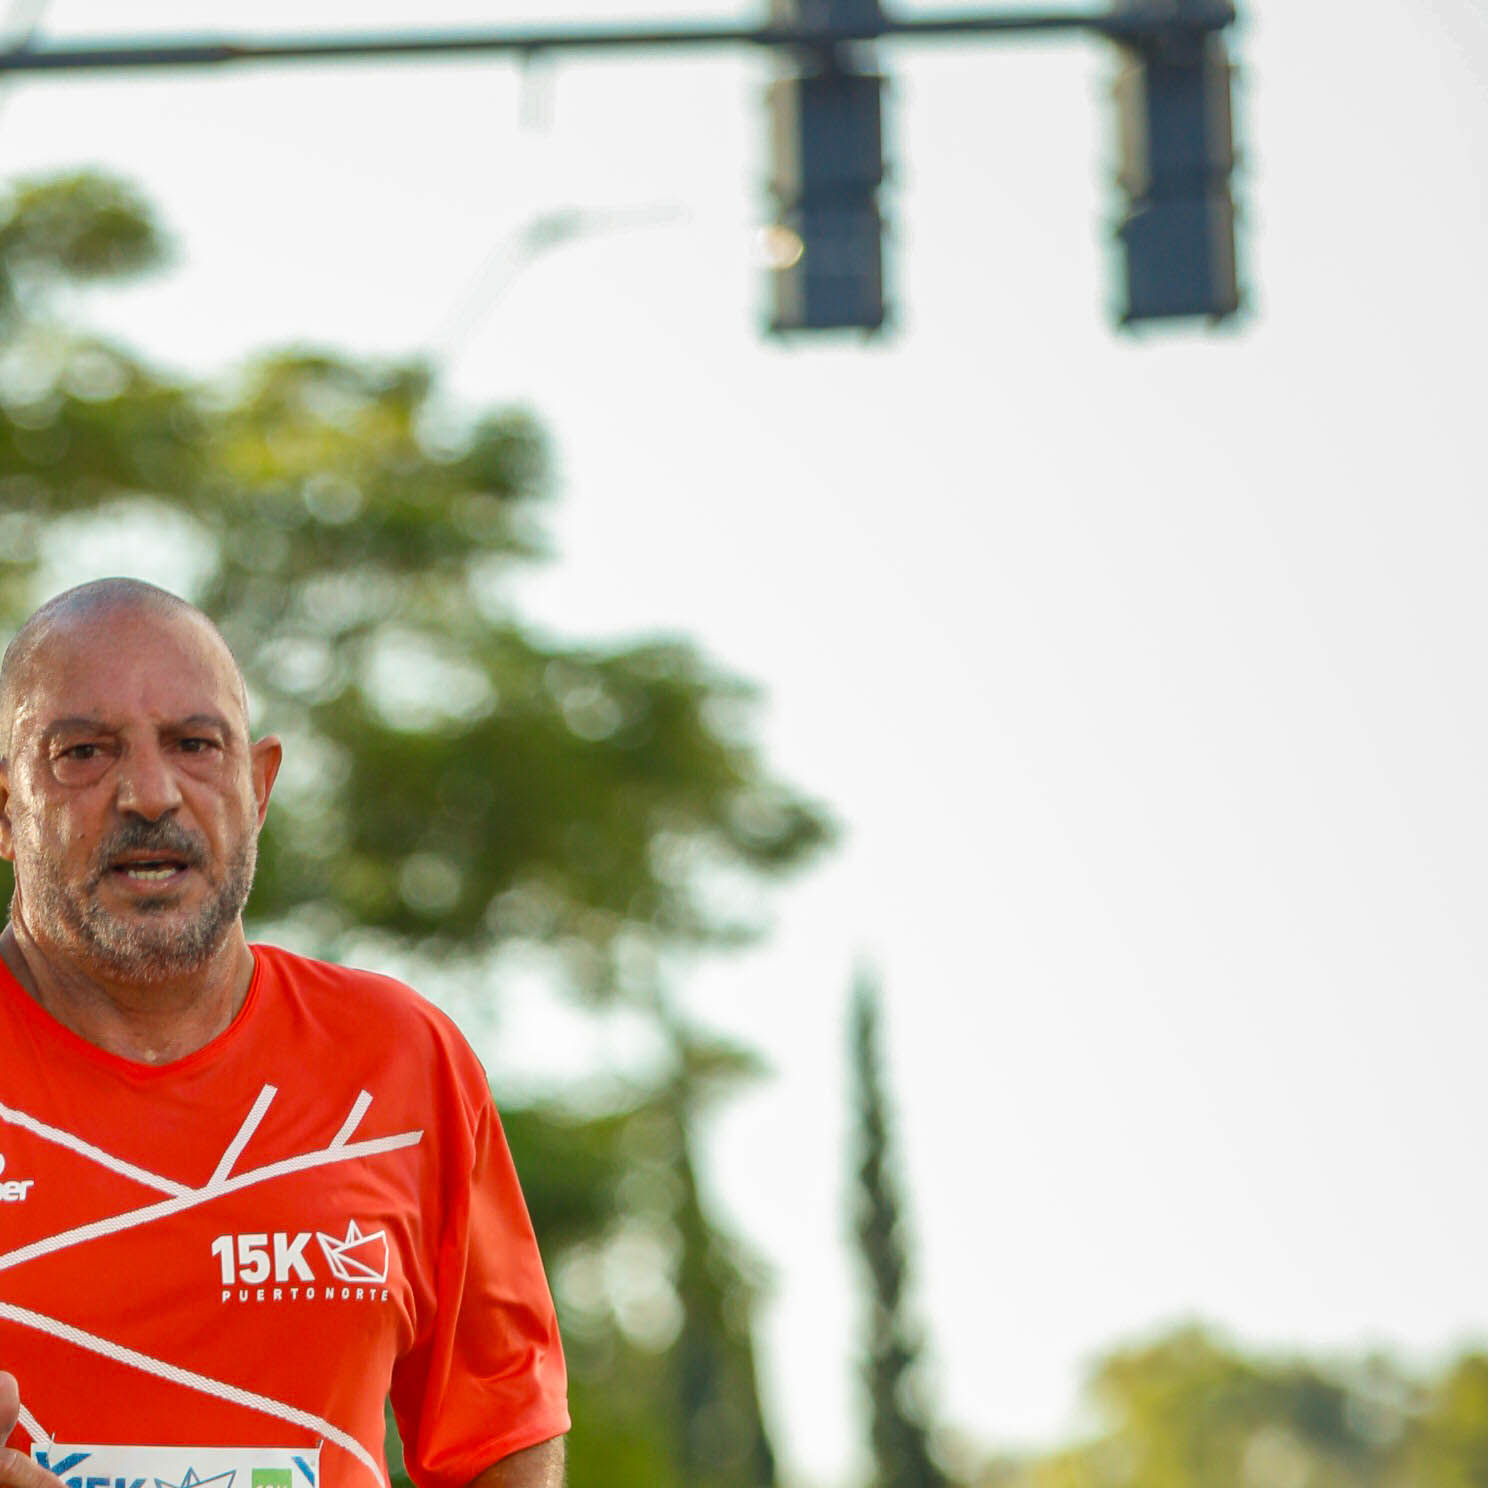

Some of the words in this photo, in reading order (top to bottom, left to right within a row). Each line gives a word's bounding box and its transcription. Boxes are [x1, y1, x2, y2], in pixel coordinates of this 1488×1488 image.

[211, 1231, 316, 1285] 15K
[222, 1287, 315, 1303] PUERTO
[325, 1287, 388, 1302] NORTE
